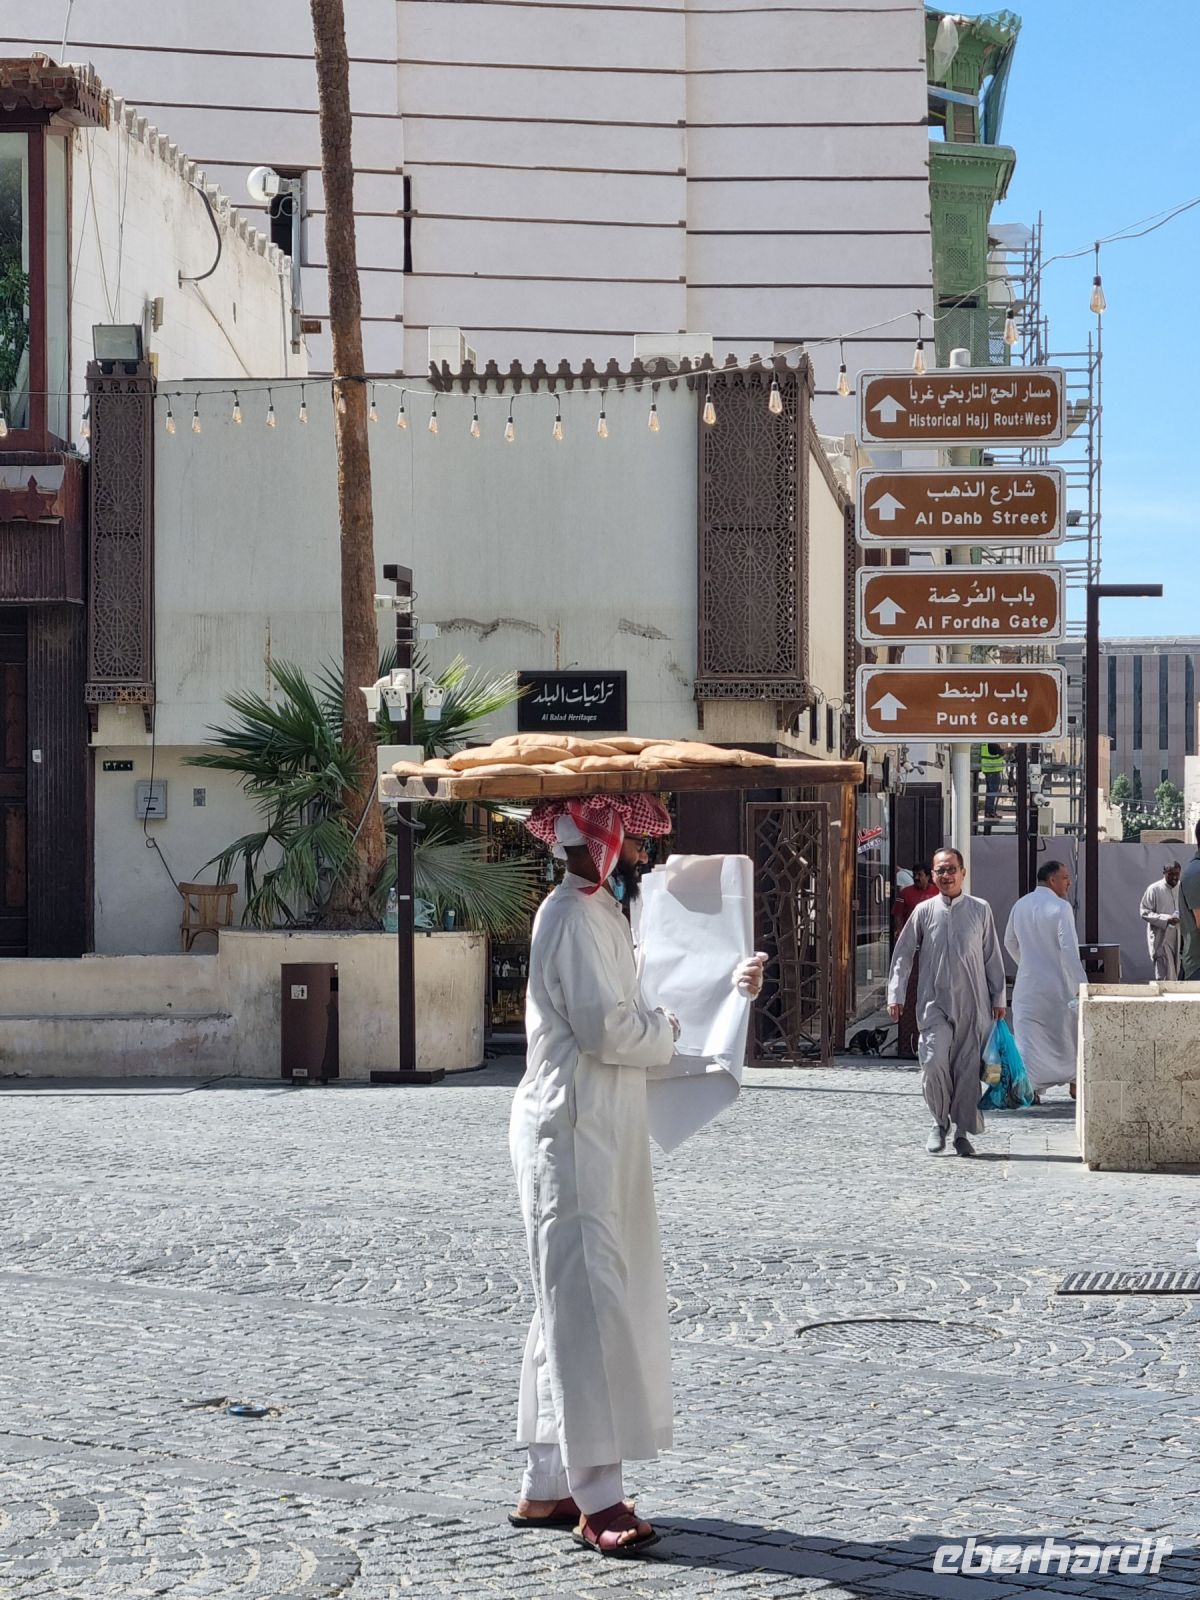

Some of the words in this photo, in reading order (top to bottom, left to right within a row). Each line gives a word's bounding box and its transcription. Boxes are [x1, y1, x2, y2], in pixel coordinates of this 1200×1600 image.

[938, 383, 987, 408] التاريخي
[990, 382, 1017, 405] الحج
[1022, 382, 1052, 402] مسار
[909, 413, 961, 428] Historical
[966, 412, 989, 429] Hajj
[1024, 412, 1052, 426] West
[927, 480, 985, 501] الذهب
[990, 480, 1036, 506] شارع
[915, 512, 933, 525] Al
[941, 511, 983, 525] Dahb
[992, 510, 1048, 524] Street
[1000, 585, 1036, 607] باب
[915, 616, 933, 629] Al
[941, 615, 1000, 629] Fordha
[1009, 614, 1049, 628] Gate
[531, 683, 565, 706] البلد
[565, 680, 614, 706] تراثيات
[937, 681, 989, 702] البنط
[993, 681, 1028, 702] باب
[549, 713, 567, 721] Balad
[936, 712, 977, 726] Punt
[987, 711, 1029, 726] Gate
